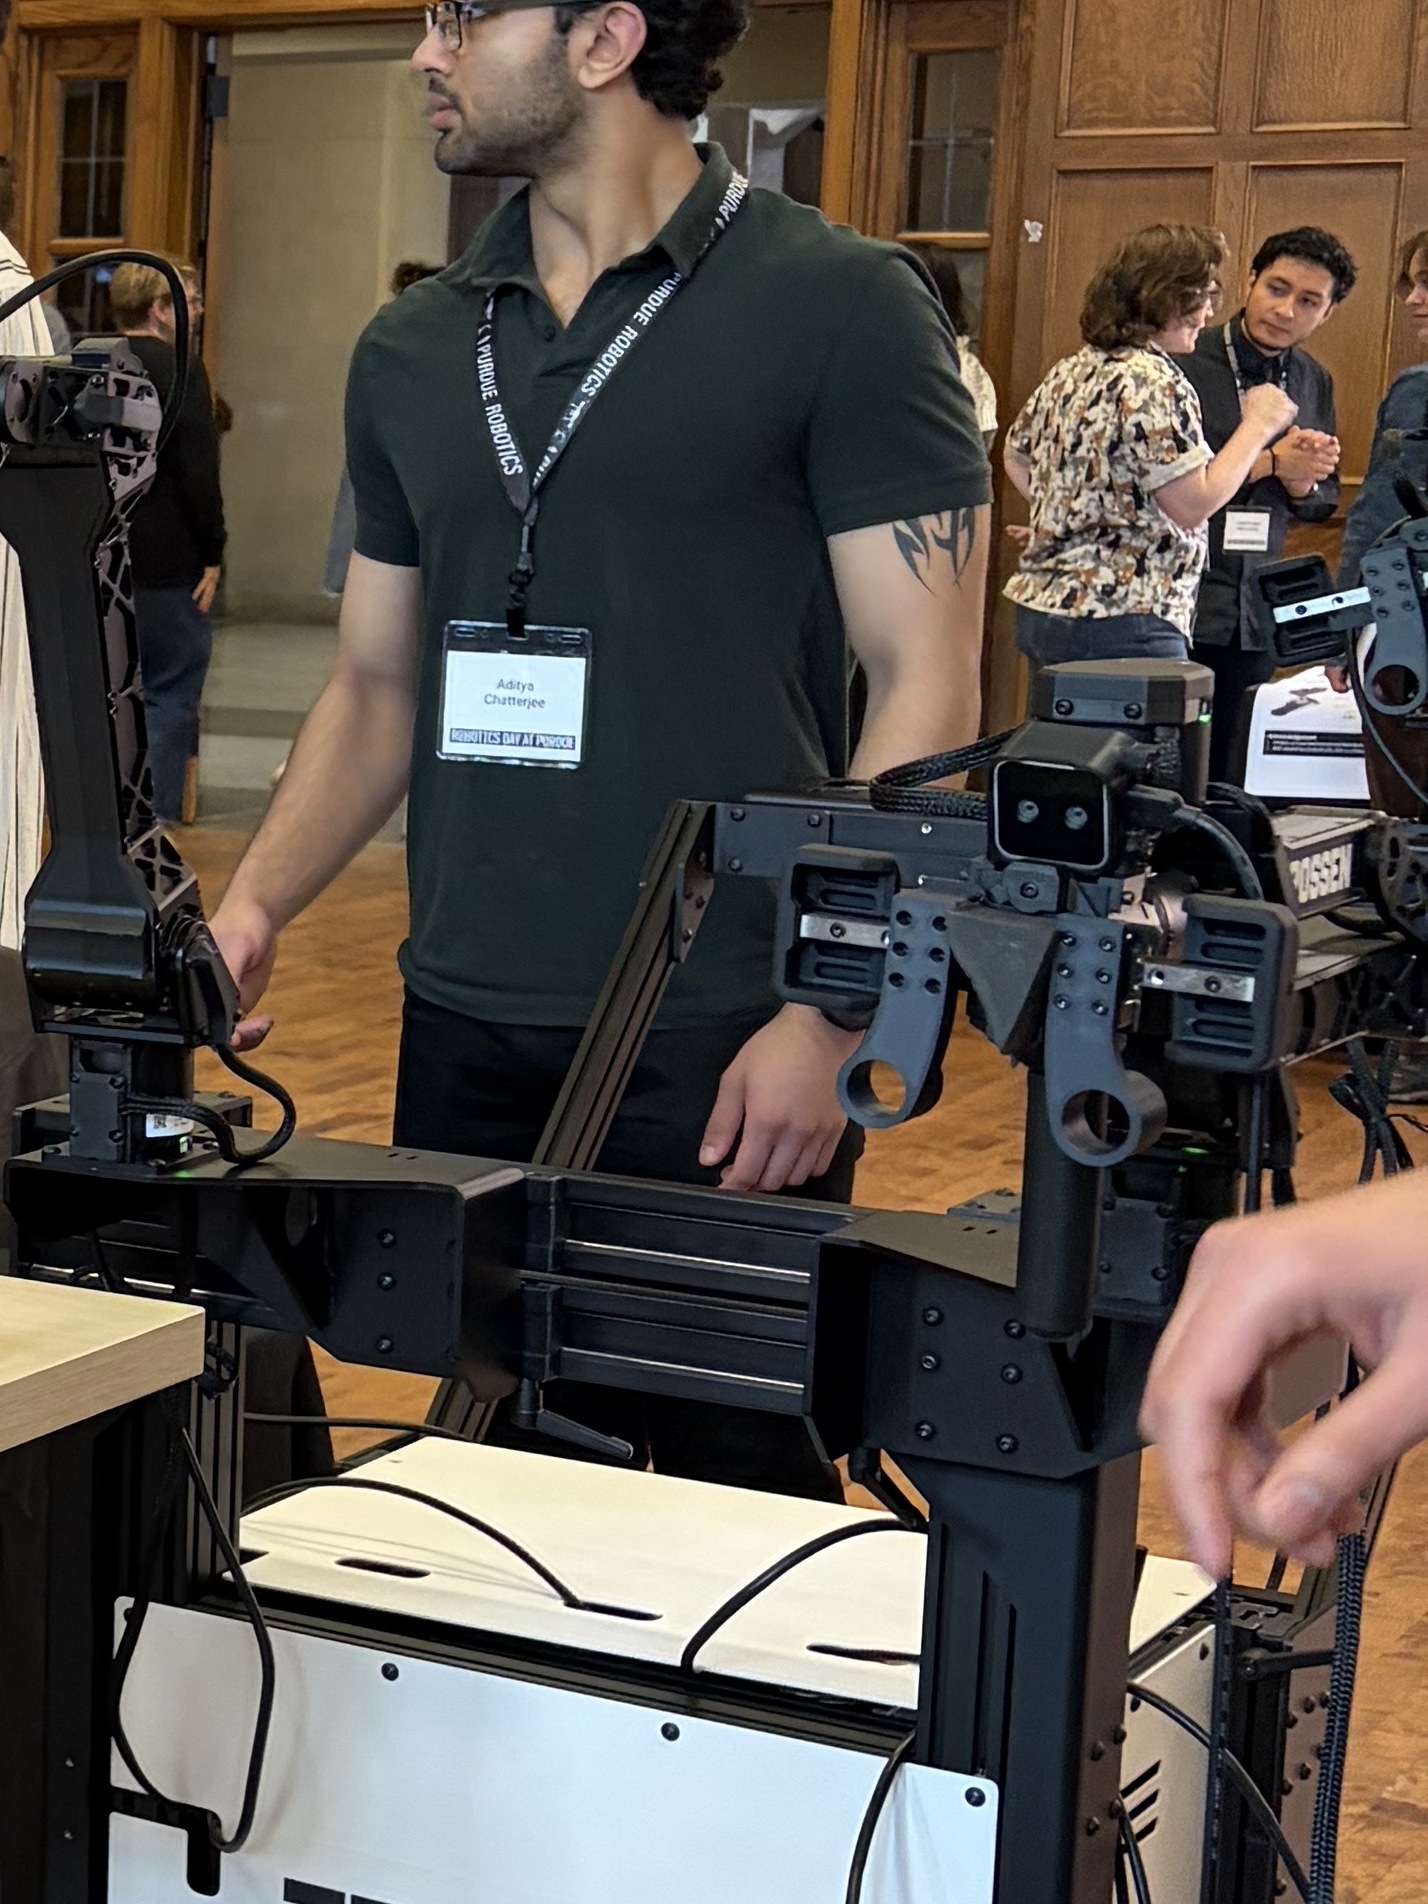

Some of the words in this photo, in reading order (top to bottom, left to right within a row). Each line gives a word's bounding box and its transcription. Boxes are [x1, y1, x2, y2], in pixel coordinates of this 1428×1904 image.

[632, 271, 682, 326] PURDUE
[477, 343, 499, 401] PURDUE
[581, 324, 639, 397] ROBOTICS
[485, 403, 524, 476] ROBOTICS
[483, 693, 546, 710] Chatterjee
[496, 678, 535, 694] Aditya
